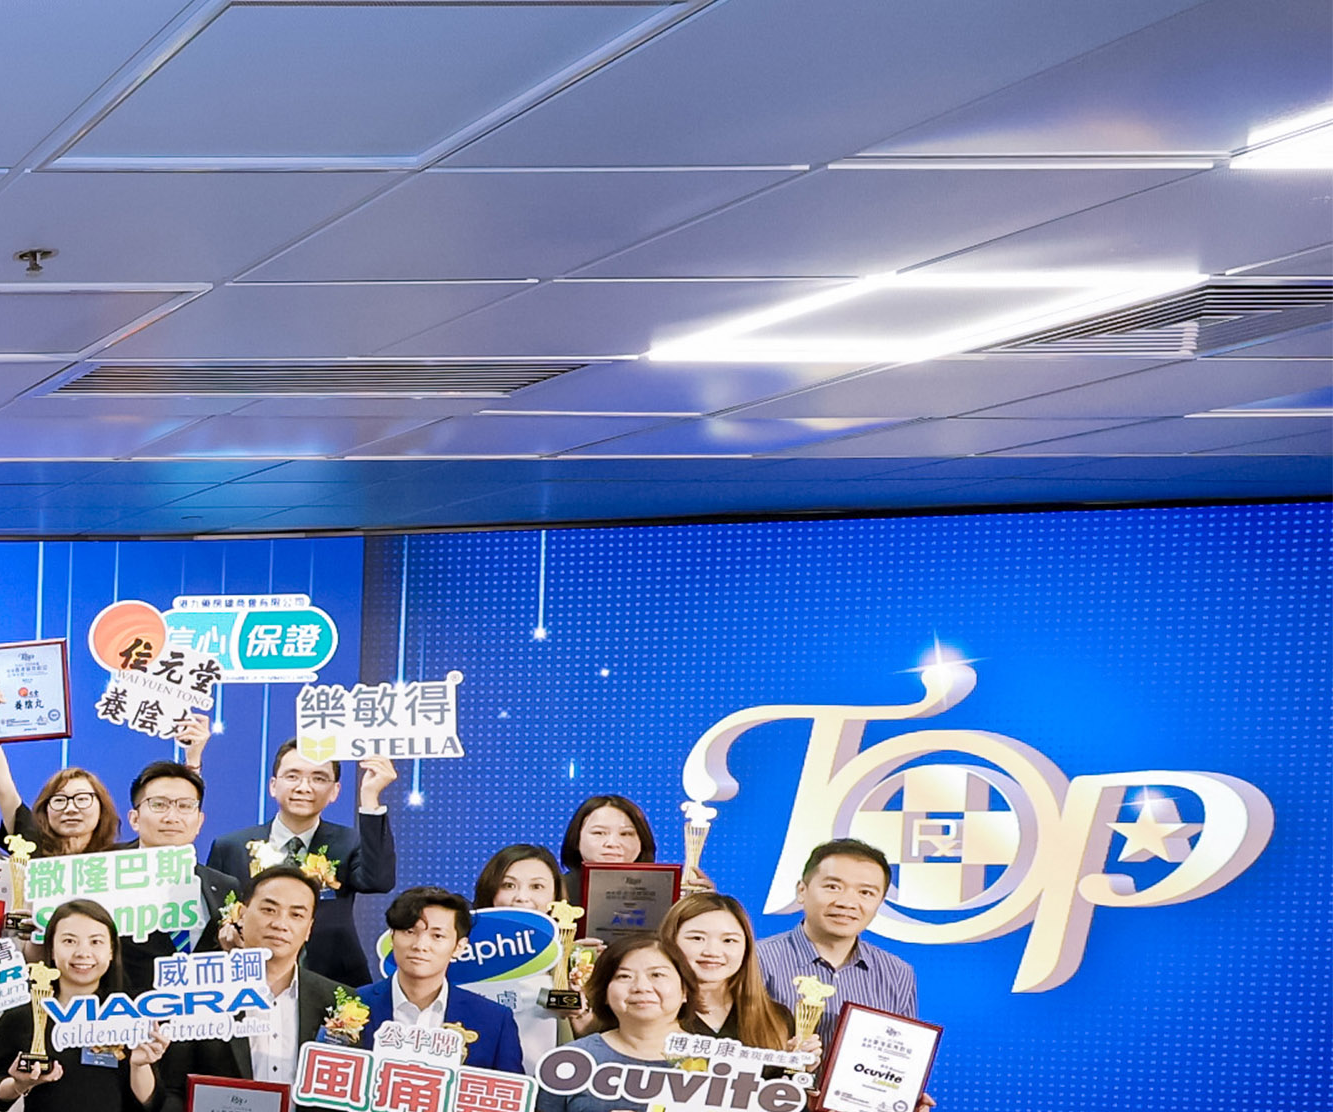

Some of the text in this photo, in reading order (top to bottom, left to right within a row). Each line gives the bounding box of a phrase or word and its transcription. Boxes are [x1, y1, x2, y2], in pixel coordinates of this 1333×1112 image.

[118, 669, 212, 711] WAI YUEN TONG
[300, 684, 451, 730] 樂敏得
[350, 736, 460, 758] STELLA
[28, 848, 194, 899] 撒隆巴斯
[156, 950, 264, 988] 威而鋼
[43, 988, 271, 1024] VIAGRA
[379, 1023, 460, 1056] 公牛牌
[853, 1063, 903, 1084] Ocuvite
